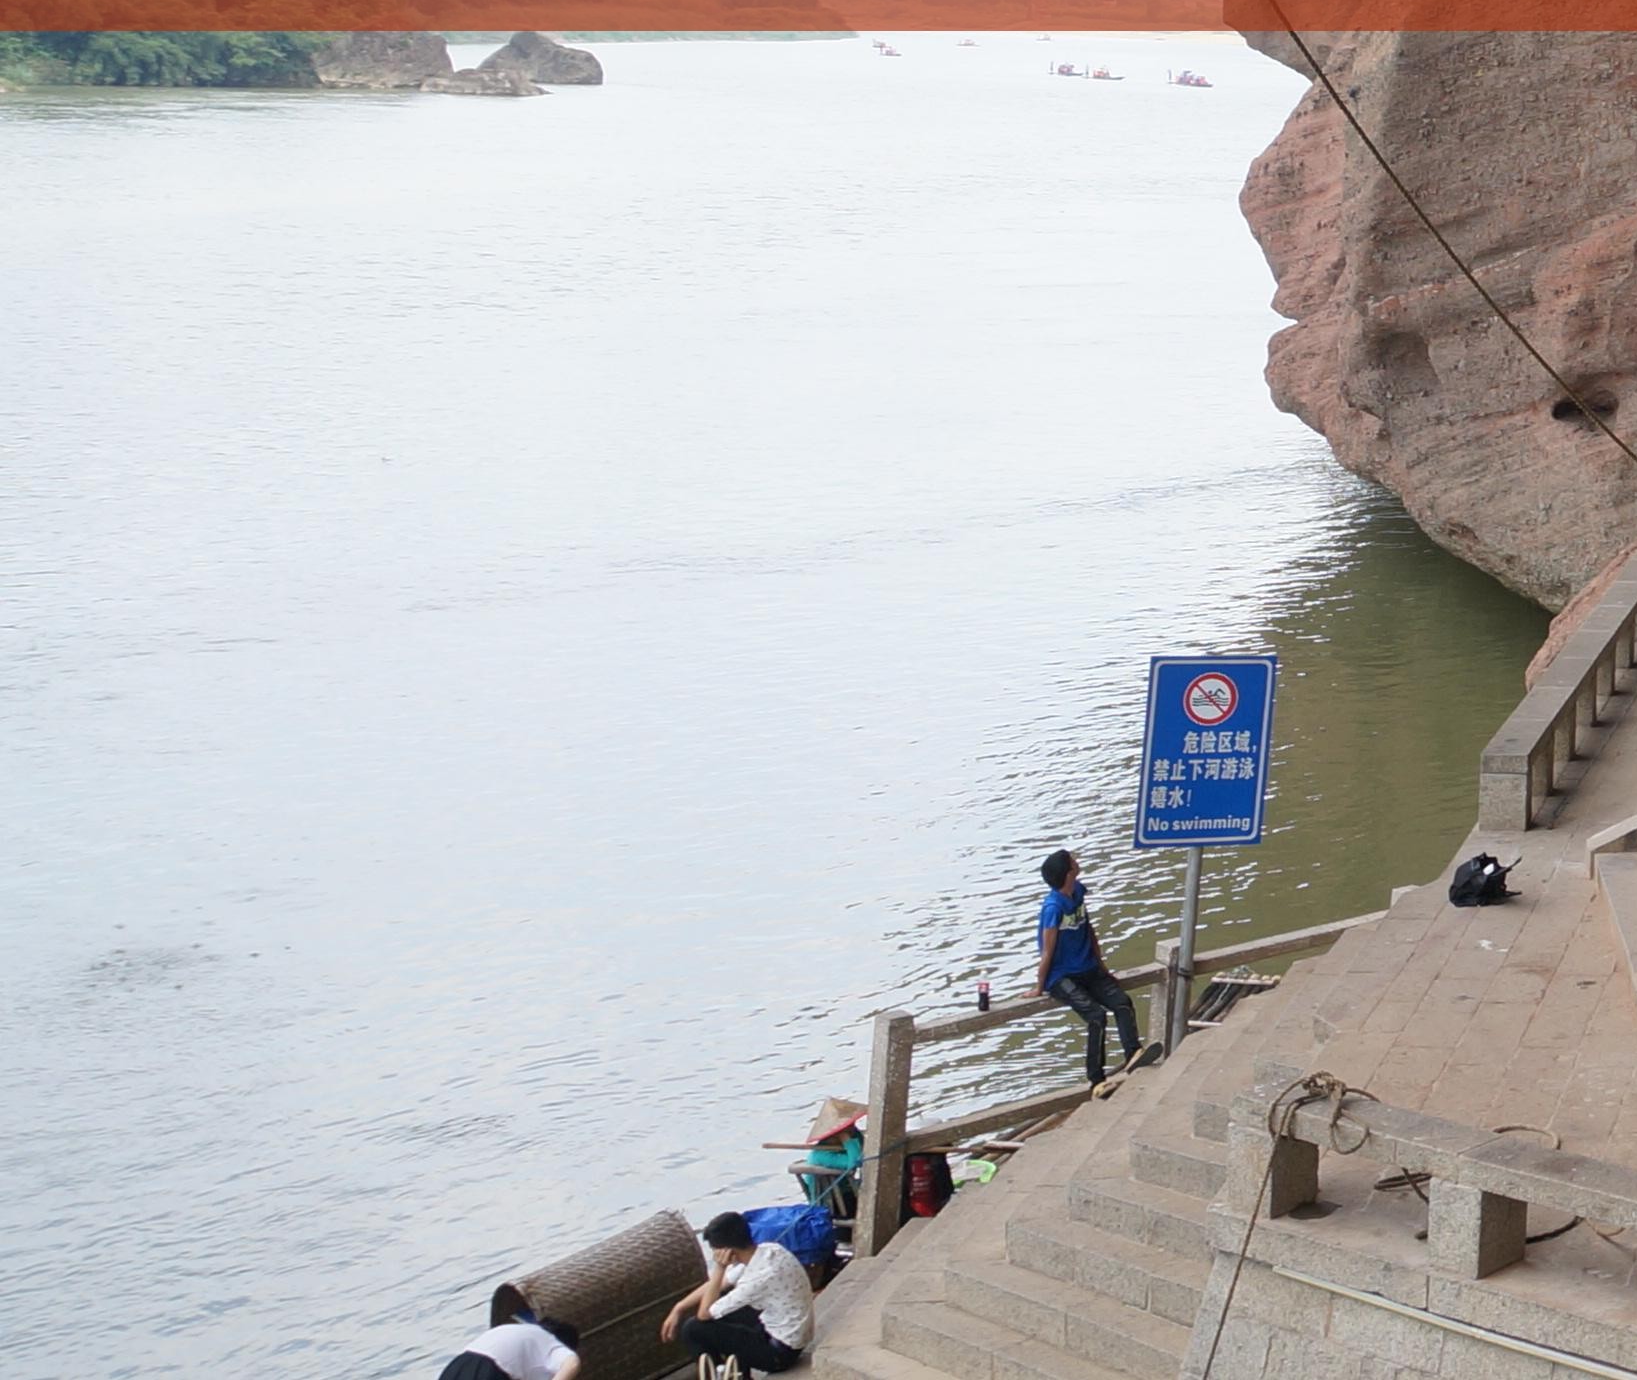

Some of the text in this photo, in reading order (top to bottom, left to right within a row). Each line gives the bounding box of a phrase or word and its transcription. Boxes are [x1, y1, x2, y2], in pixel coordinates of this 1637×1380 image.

[1152, 757, 1255, 782] 禁止下河游泳
[1147, 815, 1251, 832] No swimming
